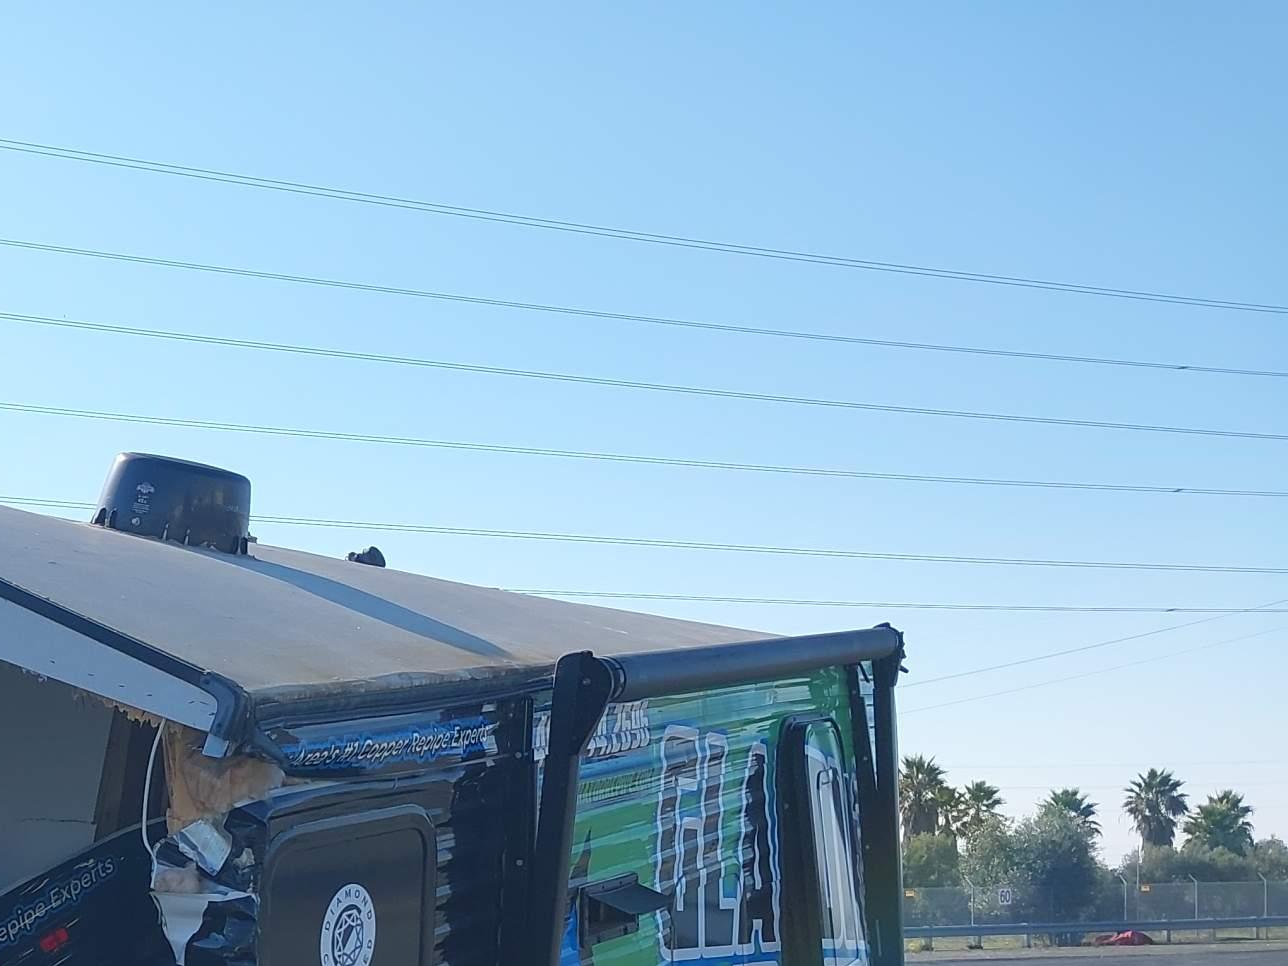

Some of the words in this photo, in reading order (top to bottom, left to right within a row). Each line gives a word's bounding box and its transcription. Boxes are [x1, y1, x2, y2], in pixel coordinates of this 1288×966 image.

[341, 742, 359, 761] #1
[358, 739, 410, 762] Copper
[411, 727, 451, 754] Repipe
[451, 724, 489, 751] Experts
[50, 857, 114, 909] Experts
[998, 888, 1011, 904] 60
[324, 887, 373, 931] DIAMOND
